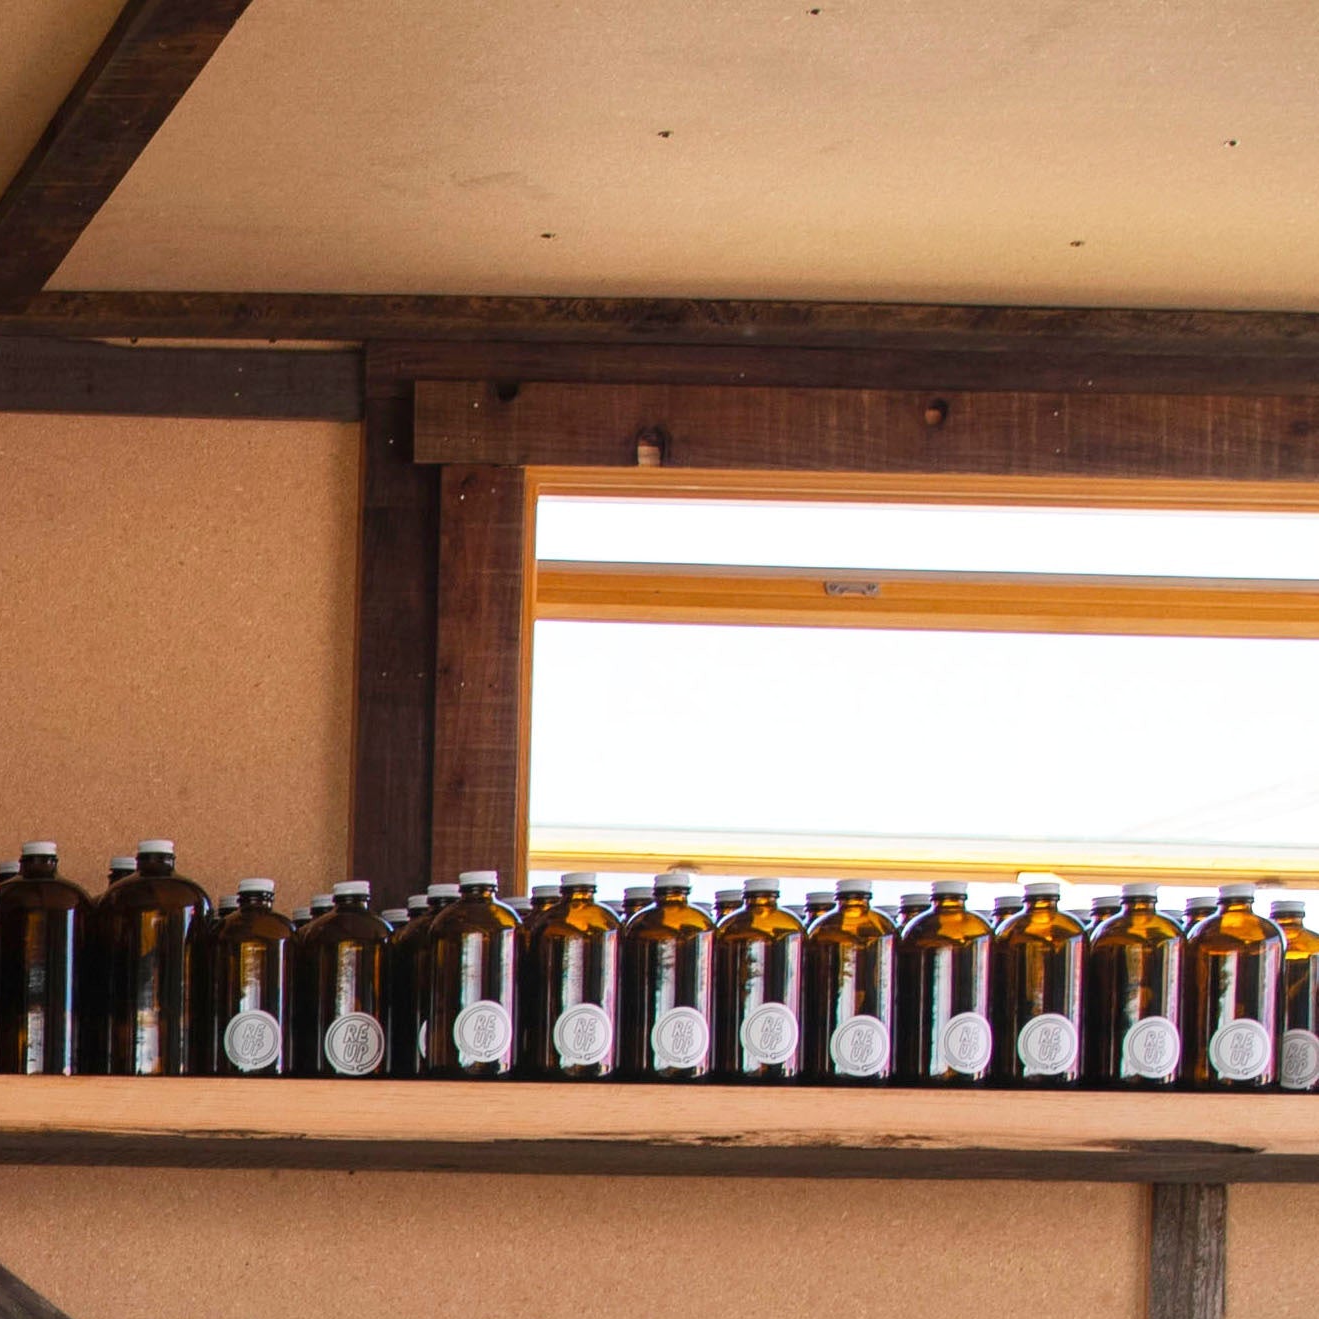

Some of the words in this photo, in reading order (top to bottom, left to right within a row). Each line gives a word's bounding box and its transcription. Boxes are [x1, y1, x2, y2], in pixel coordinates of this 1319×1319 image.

[243, 1024, 266, 1039] RE
[474, 1015, 496, 1031] RE
[574, 1018, 597, 1034] RE
[672, 1021, 694, 1037] RE
[762, 1016, 783, 1033] RE
[343, 1024, 369, 1043] RE
[473, 1030, 495, 1048] UP
[760, 1032, 782, 1050] UP
[852, 1029, 874, 1045] RE
[959, 1026, 980, 1044] RE
[1040, 1028, 1062, 1044] RE
[1144, 1030, 1166, 1048] RE
[1231, 1032, 1254, 1050] RE
[241, 1039, 264, 1057] UP
[573, 1034, 595, 1051] UP
[671, 1037, 694, 1054] UP
[343, 1043, 368, 1062] UP
[850, 1044, 873, 1062] UP
[959, 1042, 978, 1061] UP
[1039, 1043, 1061, 1061] UP
[1144, 1048, 1164, 1065] UP
[1230, 1049, 1252, 1066] UP
[1286, 1044, 1311, 1059] RE
[1285, 1059, 1308, 1076] UP
